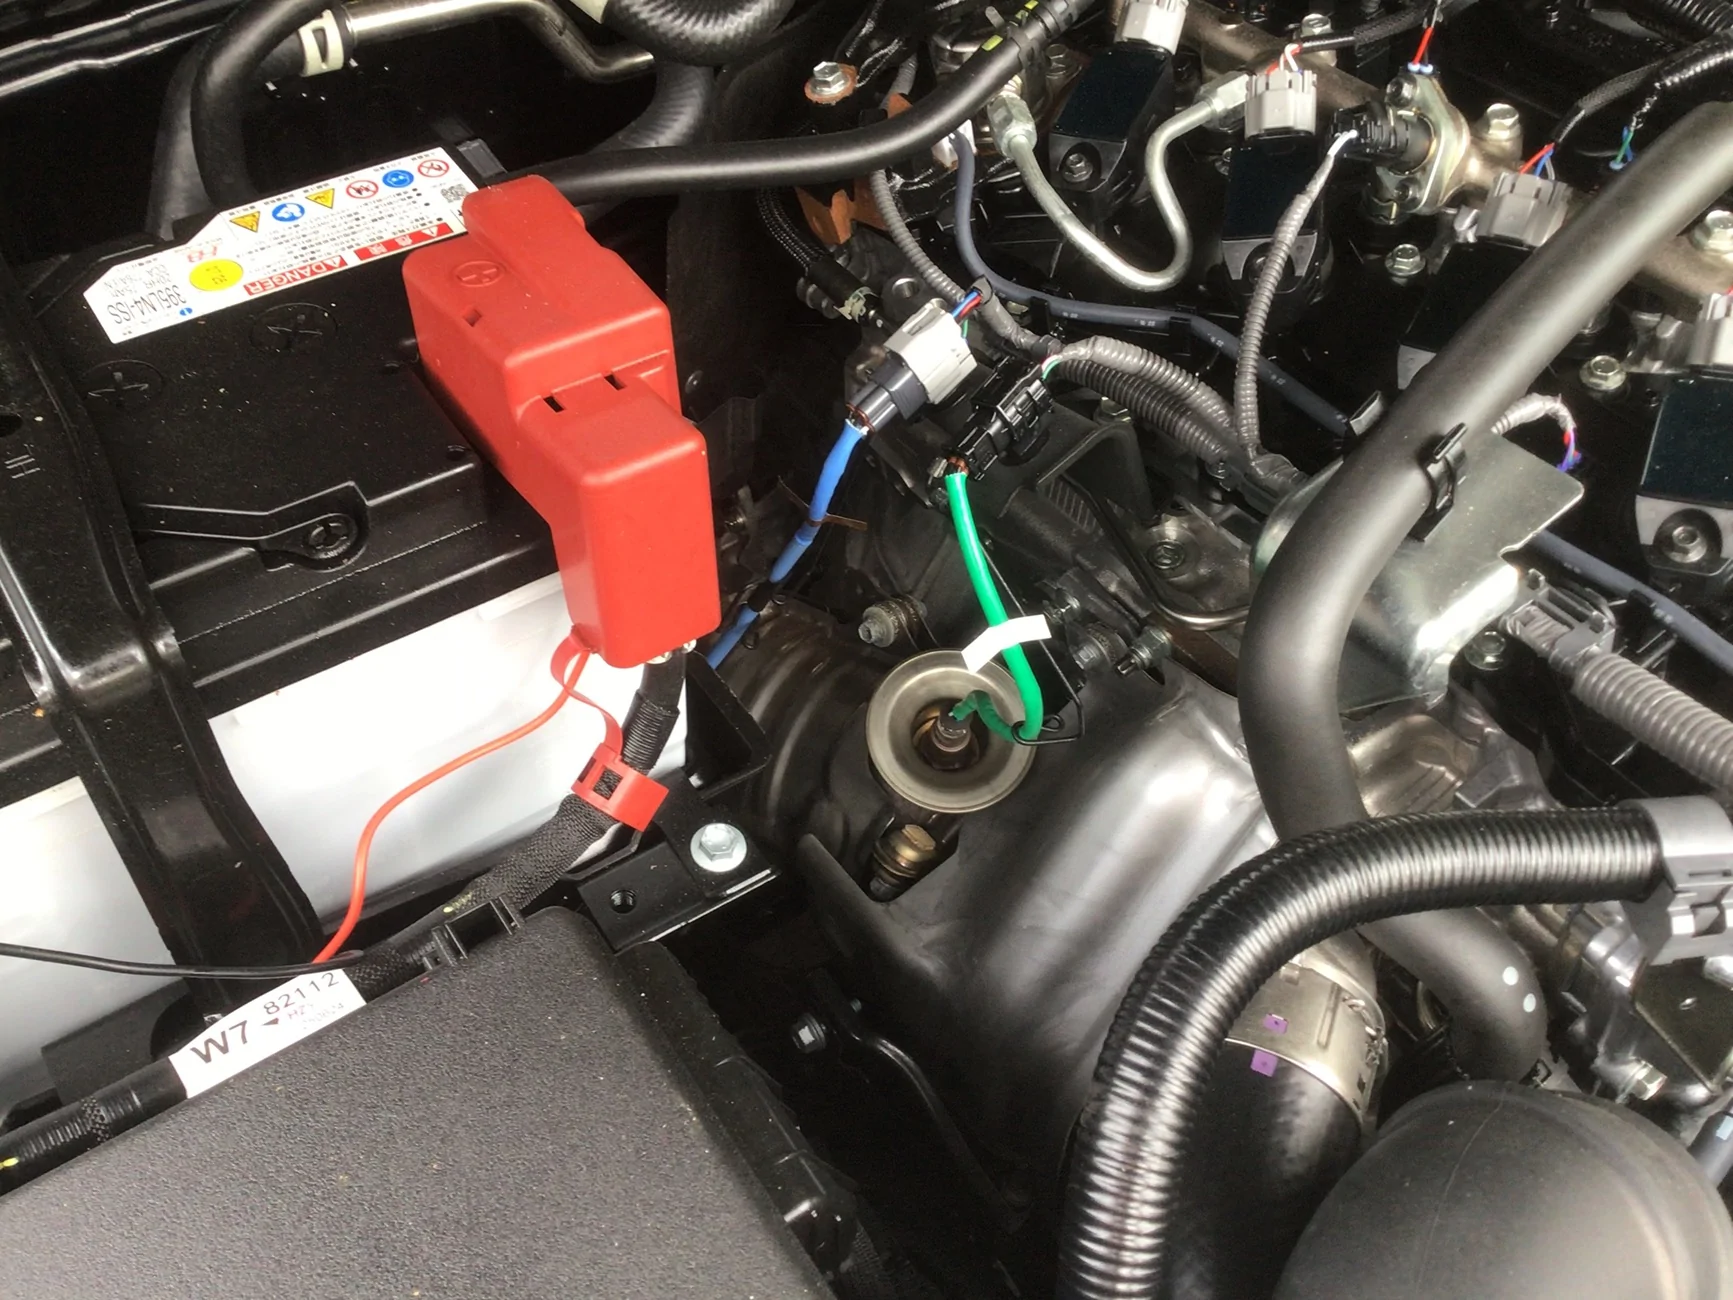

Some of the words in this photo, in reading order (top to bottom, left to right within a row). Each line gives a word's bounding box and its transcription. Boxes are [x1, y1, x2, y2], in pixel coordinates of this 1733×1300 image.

[246, 264, 328, 294] DANGER
[107, 284, 188, 325] 395LN4-ISS
[263, 972, 340, 1015] 82112
[190, 1019, 249, 1065] W7
